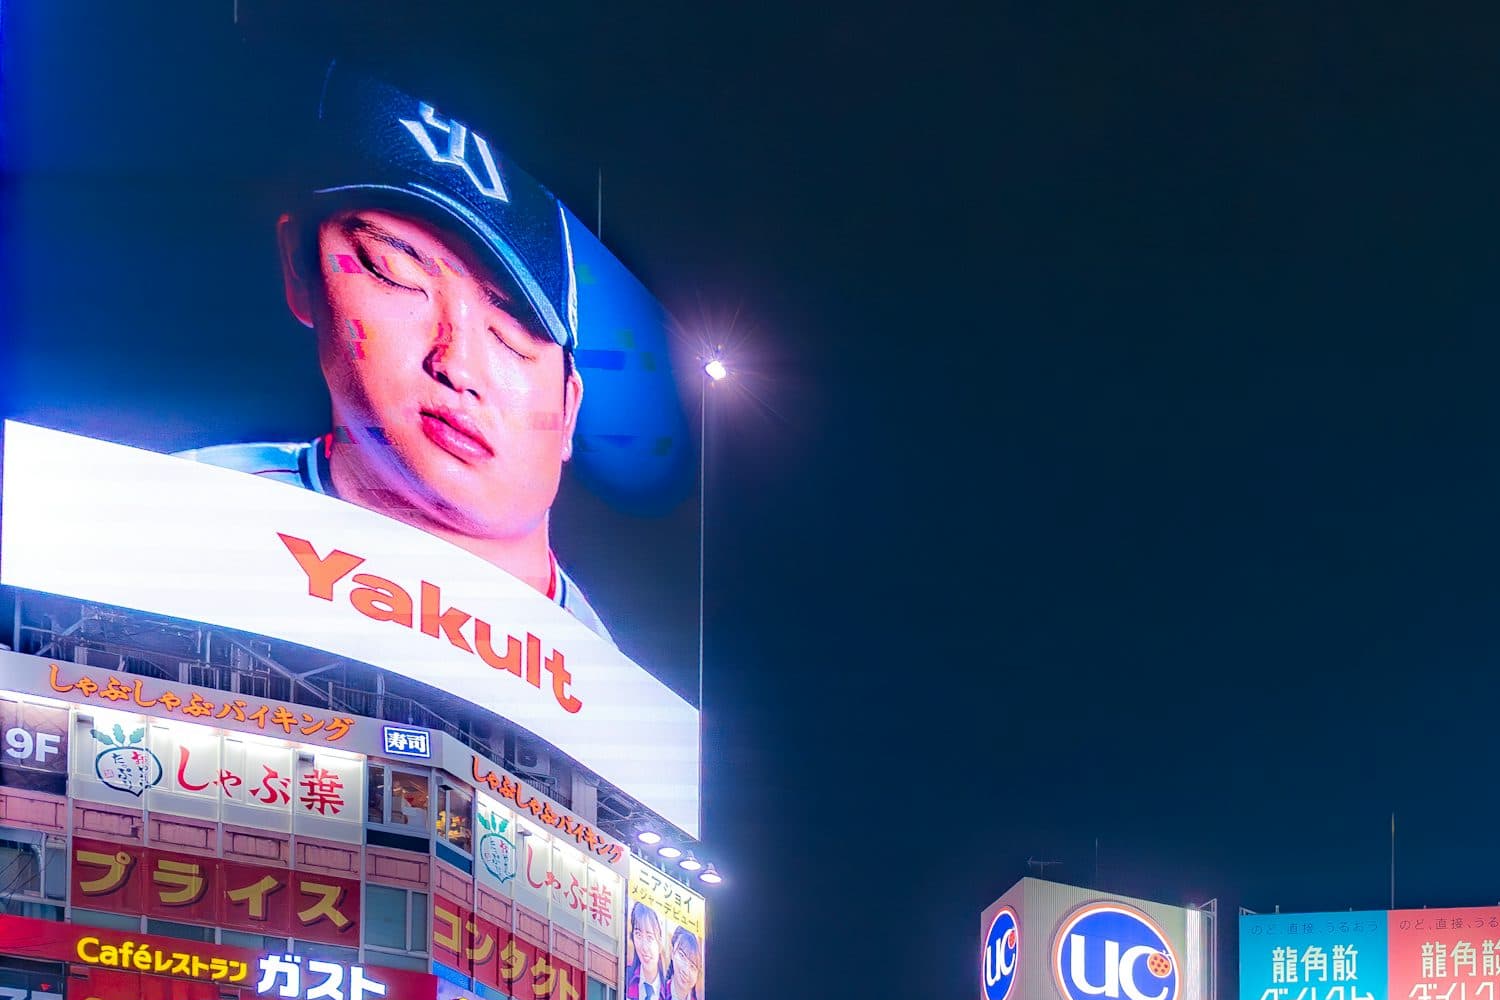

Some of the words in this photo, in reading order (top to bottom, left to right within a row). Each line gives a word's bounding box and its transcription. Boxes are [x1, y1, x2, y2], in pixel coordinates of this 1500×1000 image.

[276, 531, 583, 715] Yakult
[49, 663, 356, 742] しゃぶしゃぶバイキング
[5, 727, 62, 763] 9F
[175, 745, 346, 816] しゃぶ葉
[387, 731, 427, 754] 寿司
[471, 755, 625, 865] しゃぶしゃぶバイキング
[76, 851, 350, 928] プライス
[526, 844, 613, 928] しゃぶ葉
[1272, 944, 1359, 984] 龍角散
